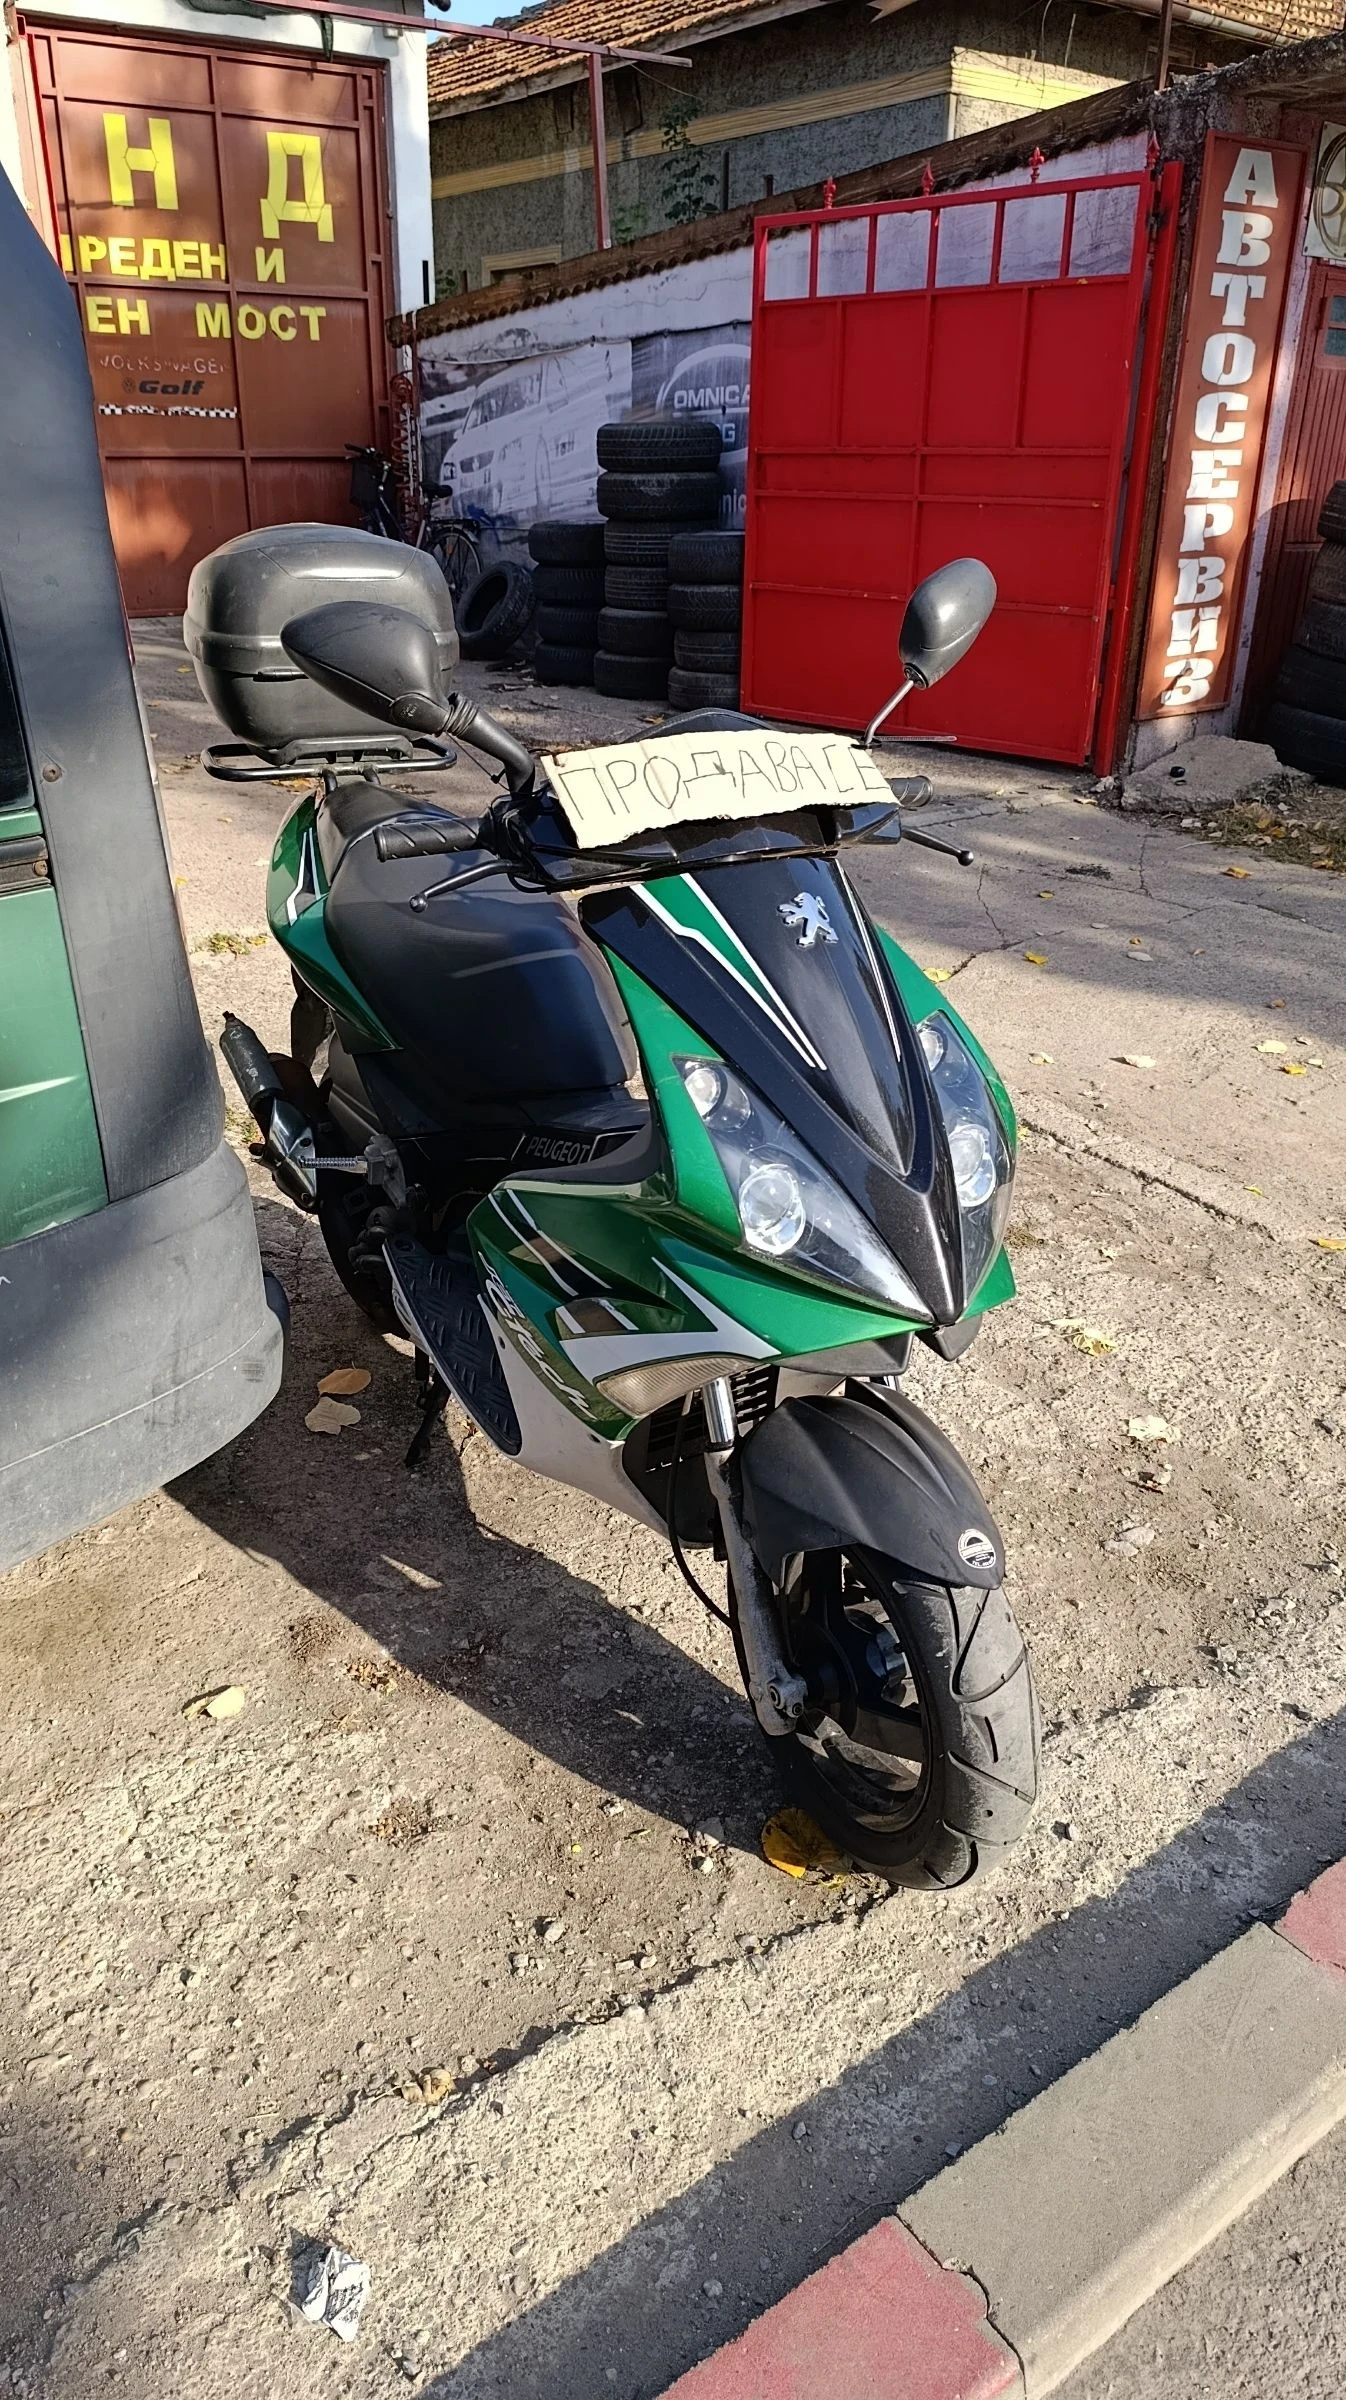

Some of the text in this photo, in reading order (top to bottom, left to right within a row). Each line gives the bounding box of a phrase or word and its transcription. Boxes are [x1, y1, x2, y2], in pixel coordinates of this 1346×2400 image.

[103, 113, 334, 242] Н Д
[255, 247, 286, 283] И
[195, 302, 327, 341] МОСТ
[139, 380, 205, 395] Golf
[1161, 148, 1279, 707] АВТОСЕРВИЗ
[526, 1136, 591, 1165] PEUGEOT
